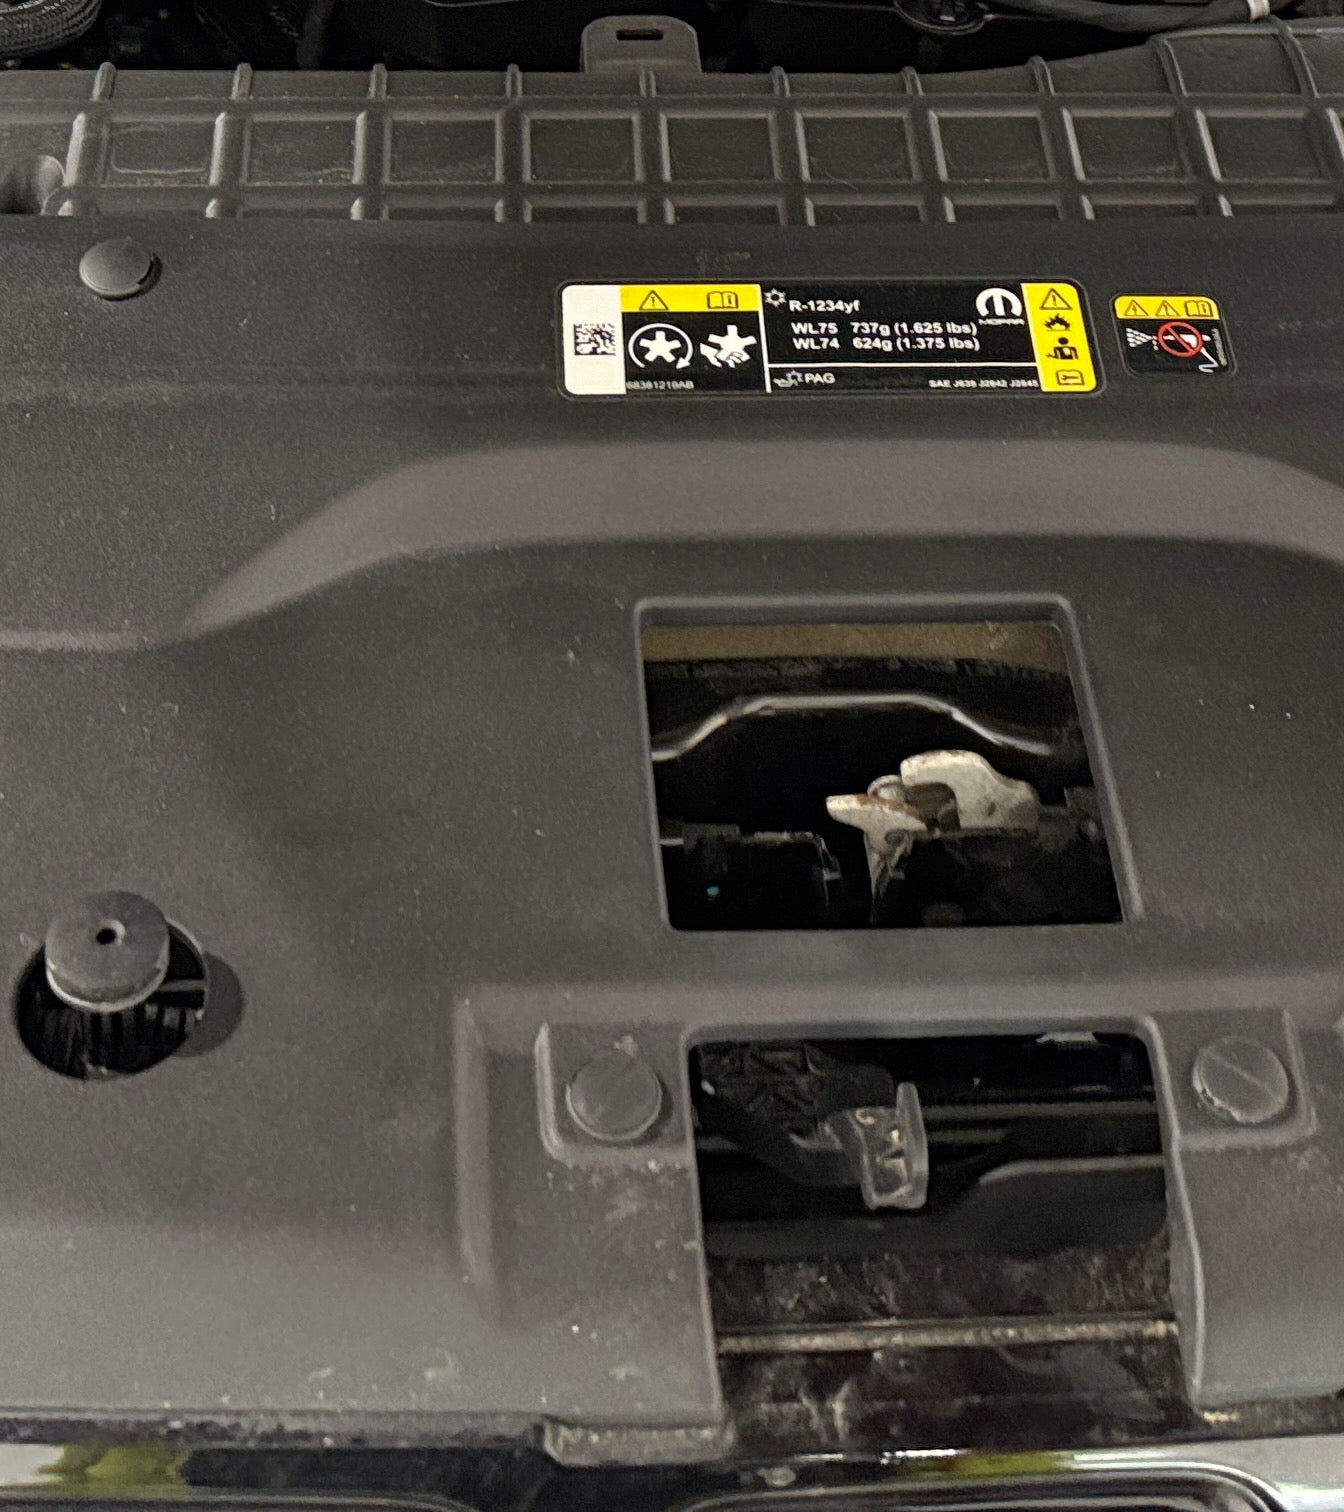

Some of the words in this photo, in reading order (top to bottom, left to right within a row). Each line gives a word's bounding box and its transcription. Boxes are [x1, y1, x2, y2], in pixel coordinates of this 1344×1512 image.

[788, 299, 861, 315] R-1234yf
[791, 322, 839, 335] WL75
[849, 321, 891, 337] 737g
[894, 321, 943, 336] (1.625
[945, 321, 978, 337] lbs)
[793, 337, 840, 350] WL74
[852, 337, 893, 352] 624g
[896, 337, 946, 352] (1.375
[948, 337, 981, 352] lbs)
[804, 372, 836, 384] PAG
[928, 379, 952, 389] SAE
